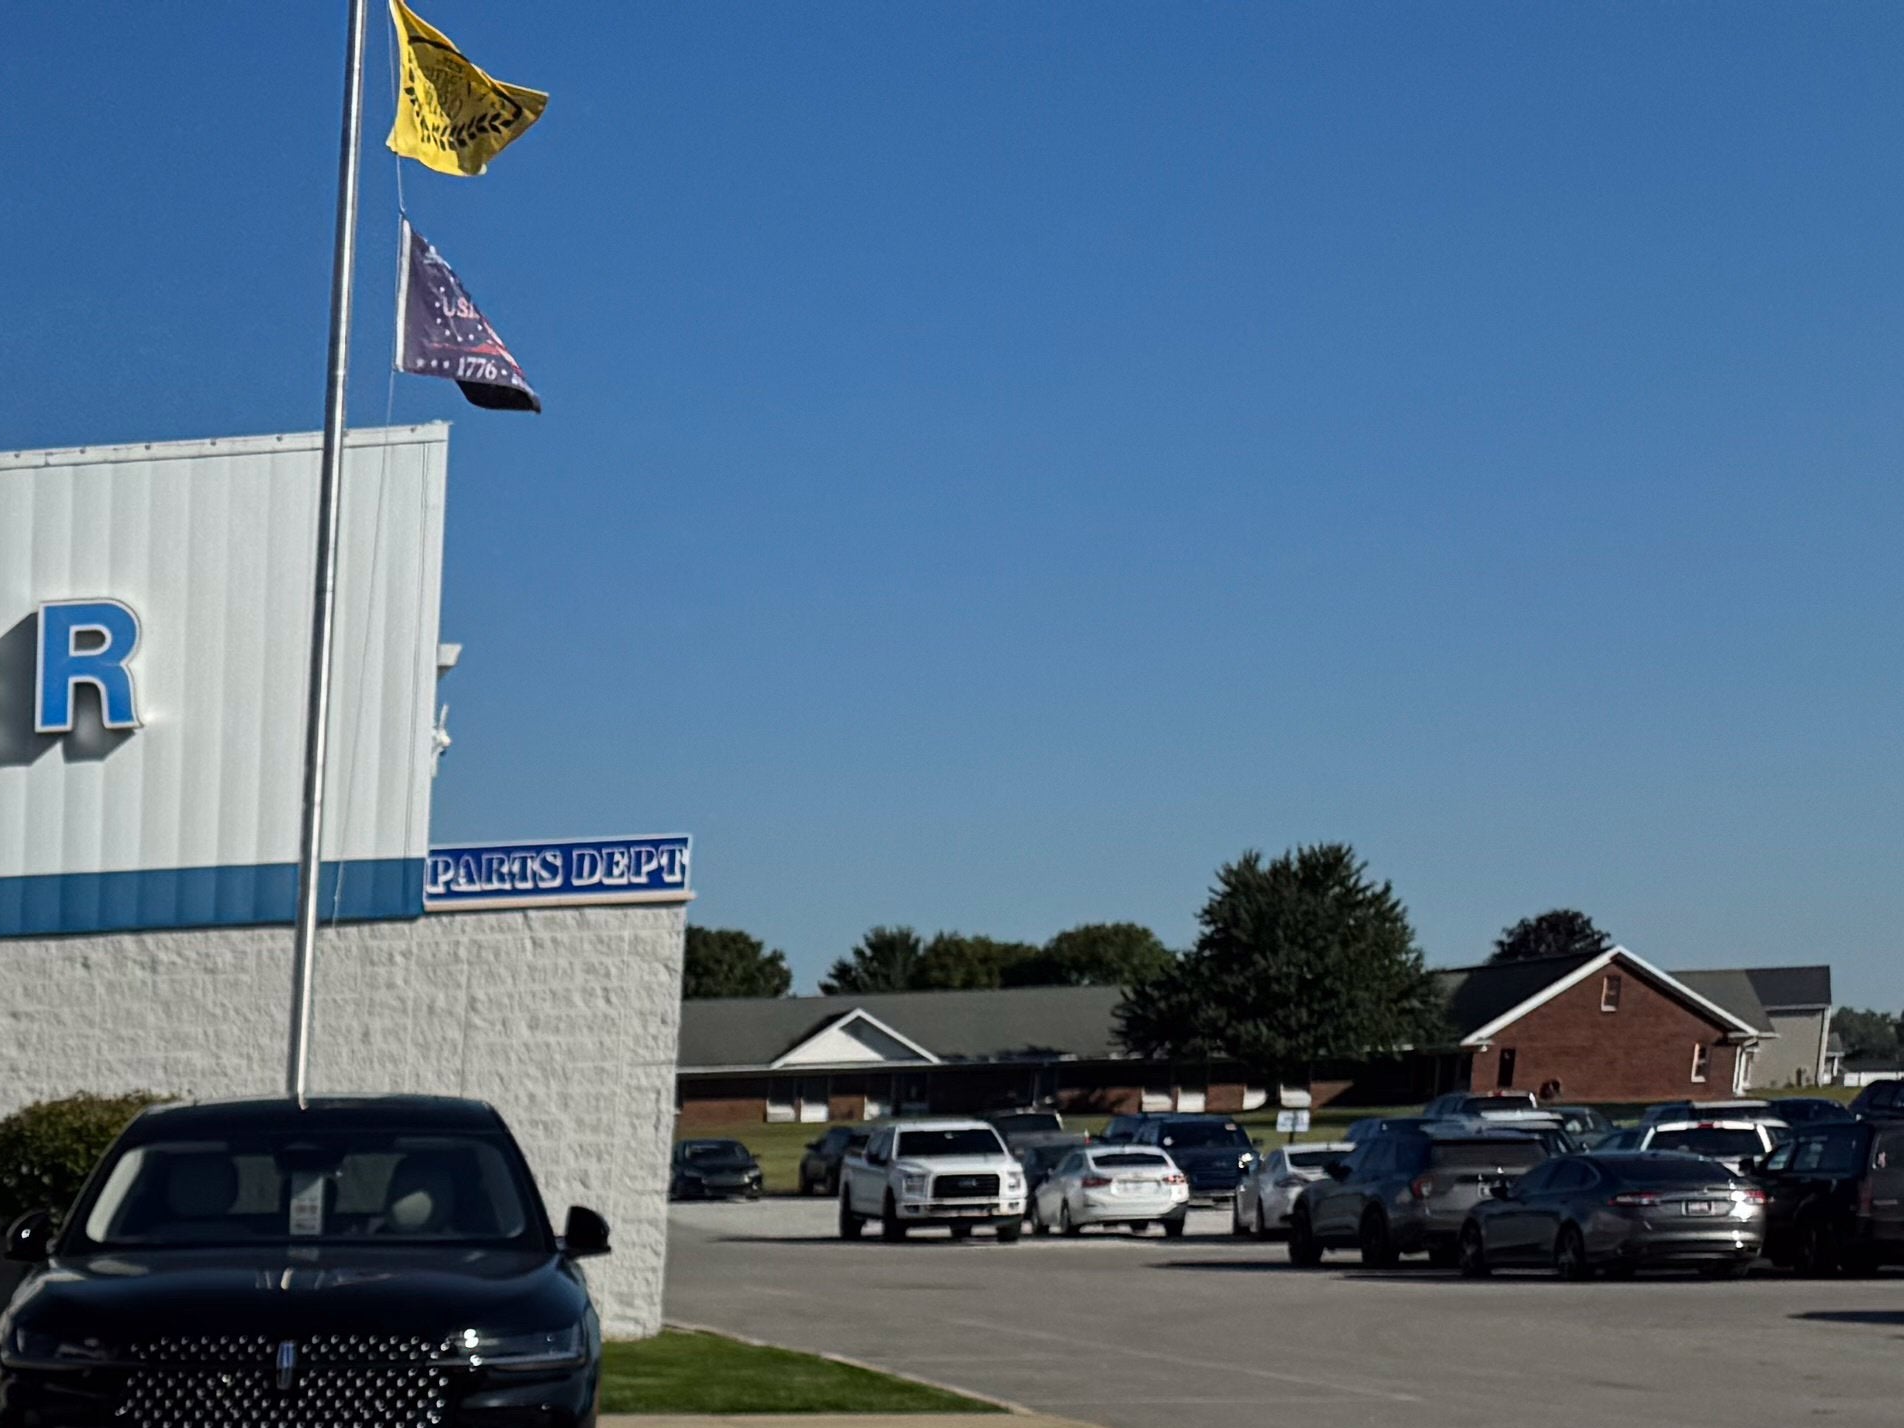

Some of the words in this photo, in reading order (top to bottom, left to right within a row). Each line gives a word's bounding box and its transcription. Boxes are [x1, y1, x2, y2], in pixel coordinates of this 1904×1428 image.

[456, 356, 498, 380] 1776
[426, 849, 563, 895] PARTS
[571, 844, 690, 887] DEPT
